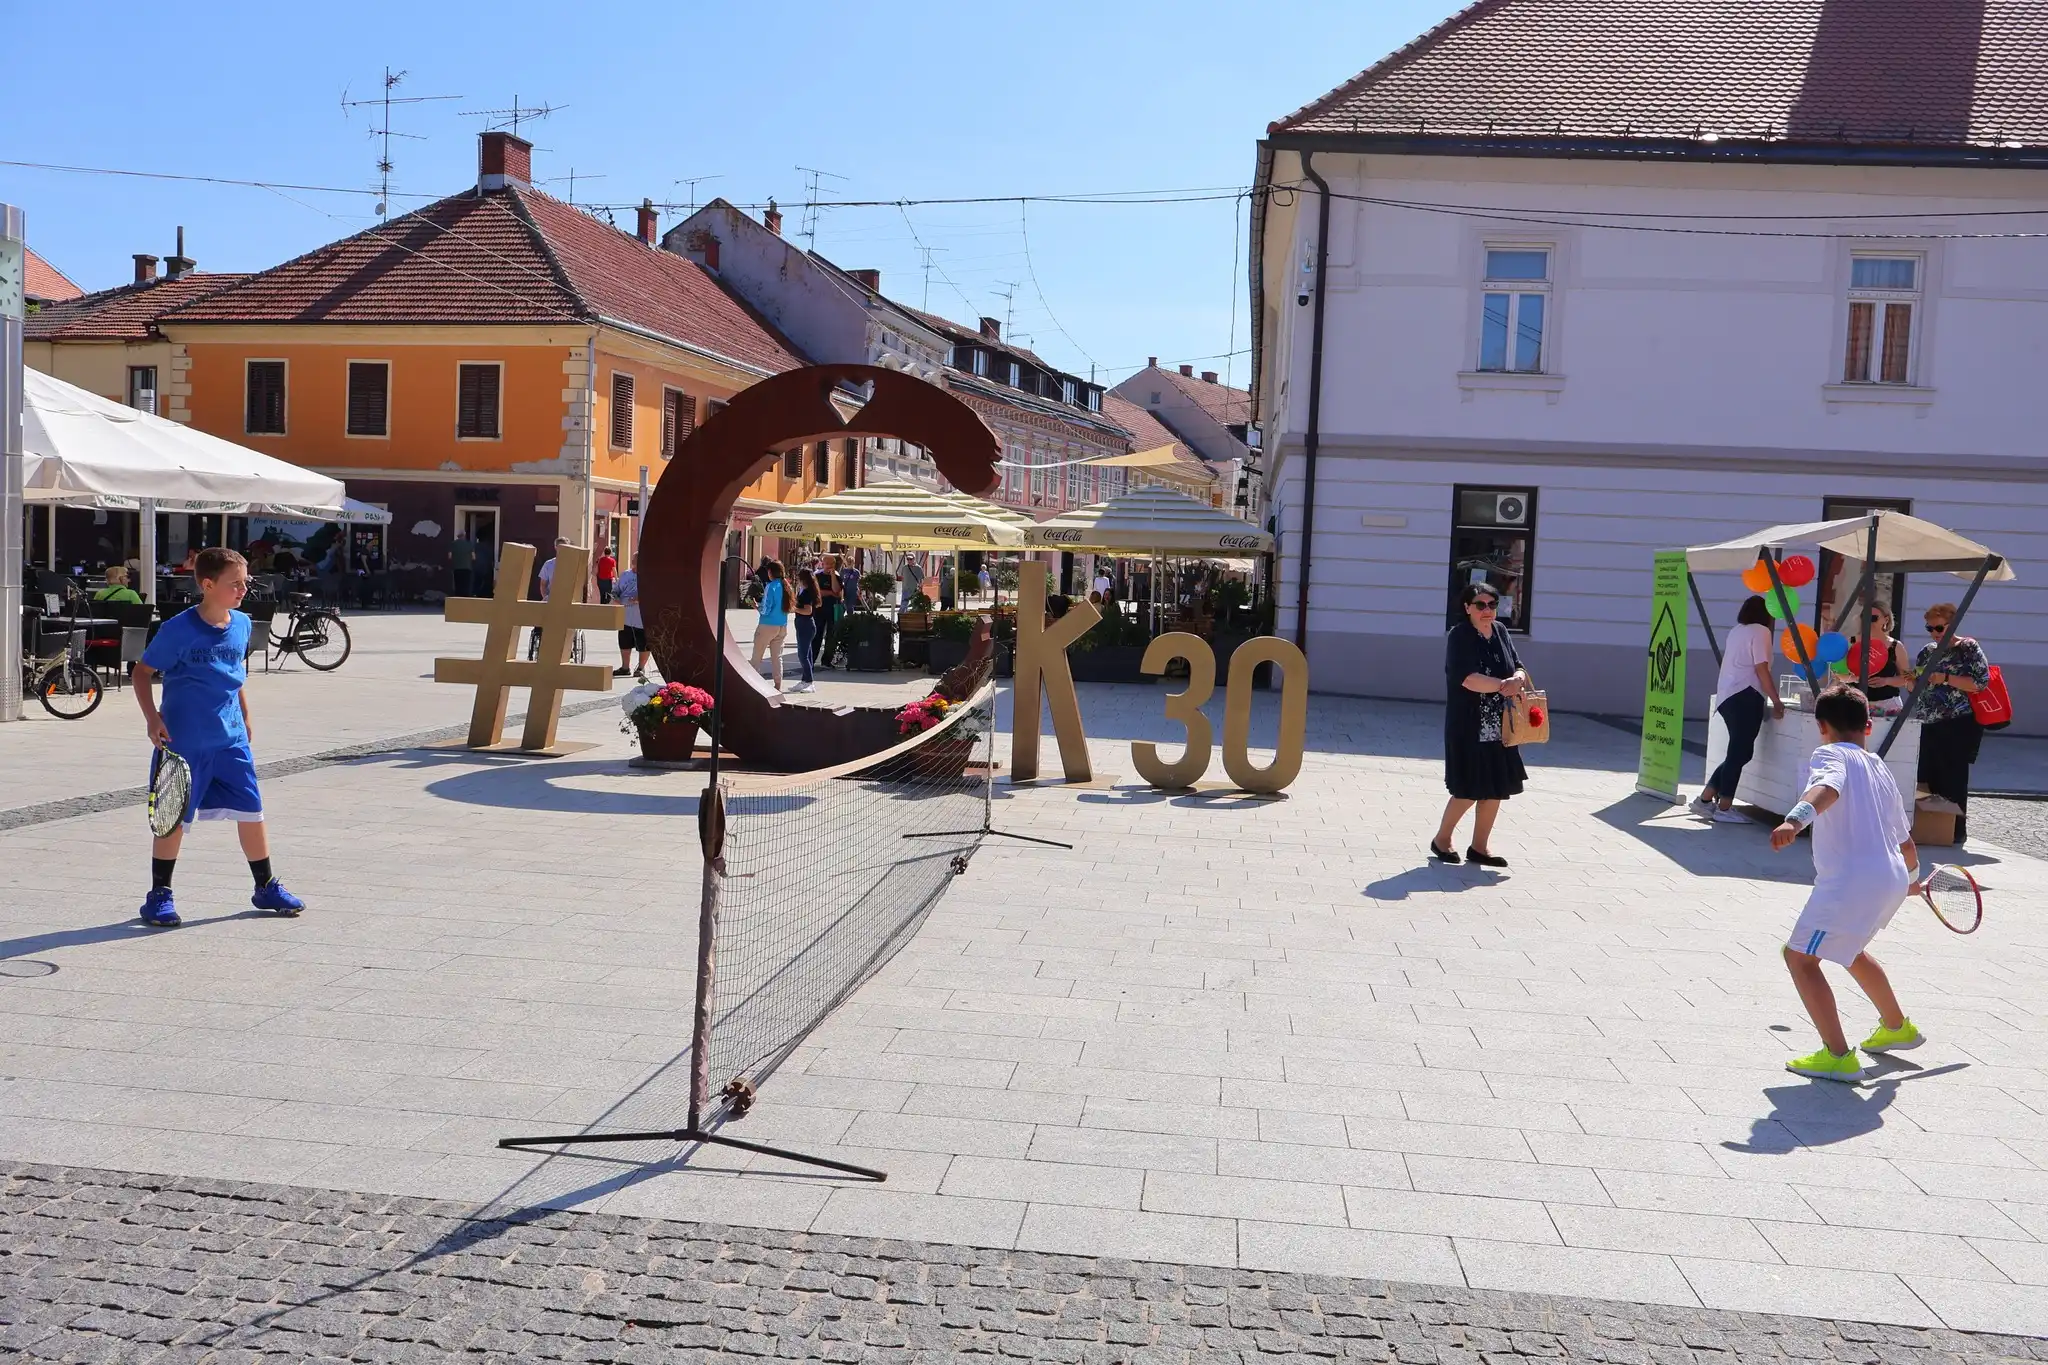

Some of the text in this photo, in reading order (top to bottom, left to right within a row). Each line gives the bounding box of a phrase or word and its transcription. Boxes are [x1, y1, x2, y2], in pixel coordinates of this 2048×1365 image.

[185, 500, 202, 510] PAN
[302, 507, 318, 516] PAN
[336, 511, 351, 520] PAN
